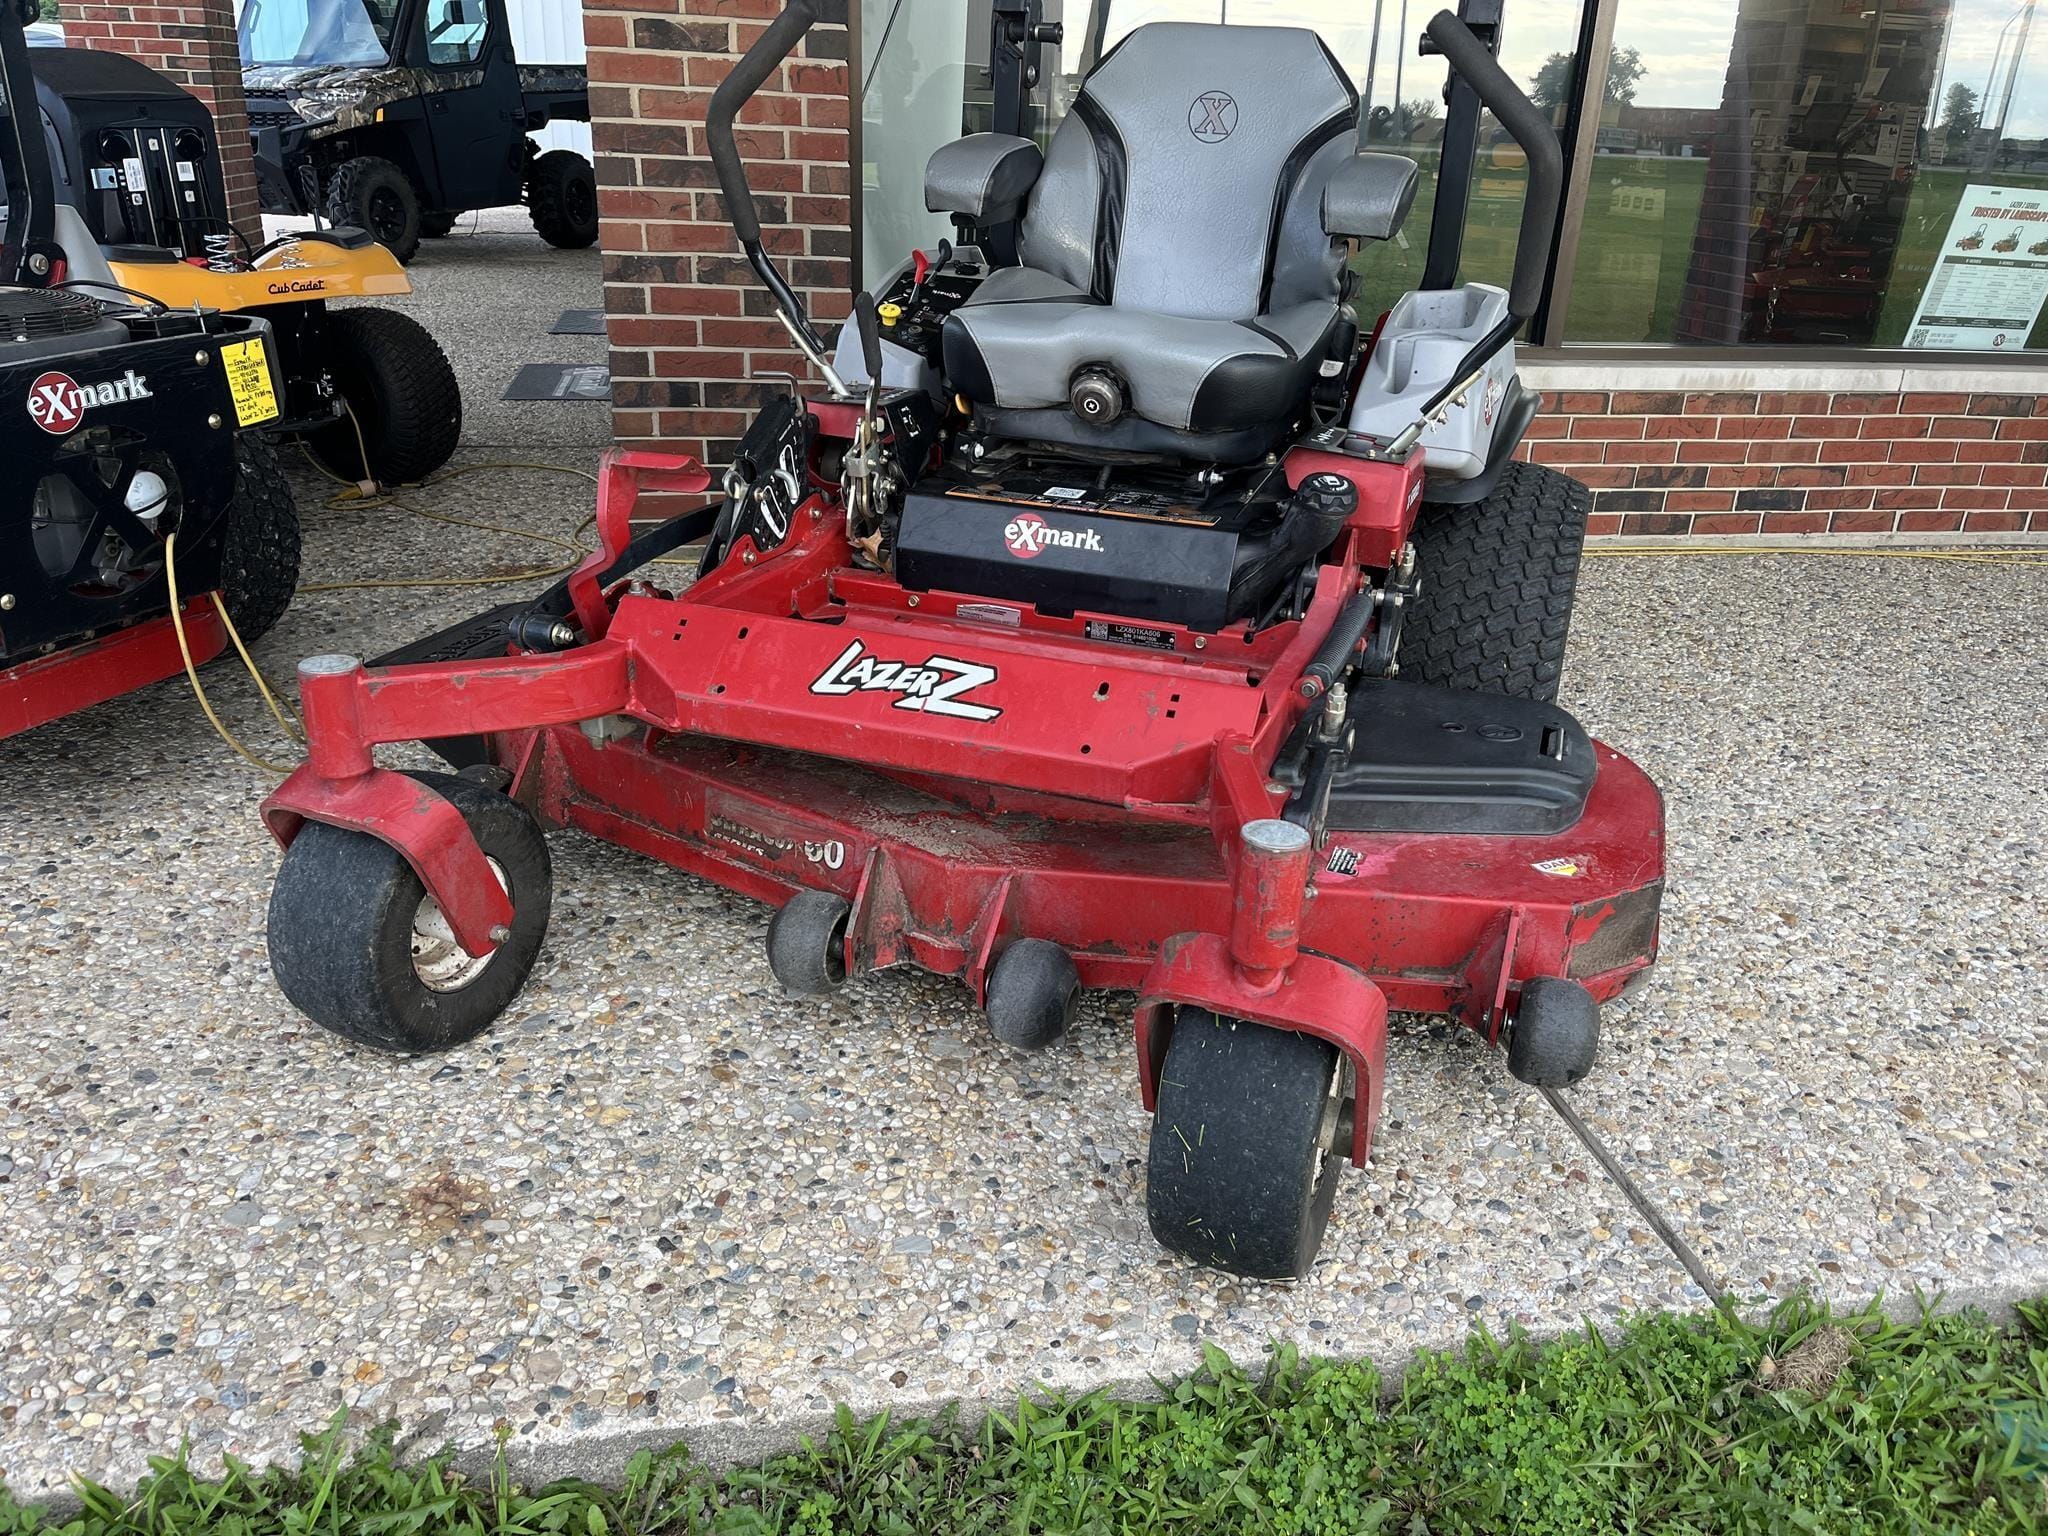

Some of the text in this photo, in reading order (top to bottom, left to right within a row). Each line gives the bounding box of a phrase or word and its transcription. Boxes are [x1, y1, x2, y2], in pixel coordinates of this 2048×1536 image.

[1971, 207, 2002, 218] TRUSTED
[1999, 208, 2013, 219] BY
[268, 280, 325, 294] Cub Cadet
[27, 370, 152, 425] eXmark
[1004, 519, 1104, 552] eXmark
[809, 638, 1003, 722] LAZER Z
